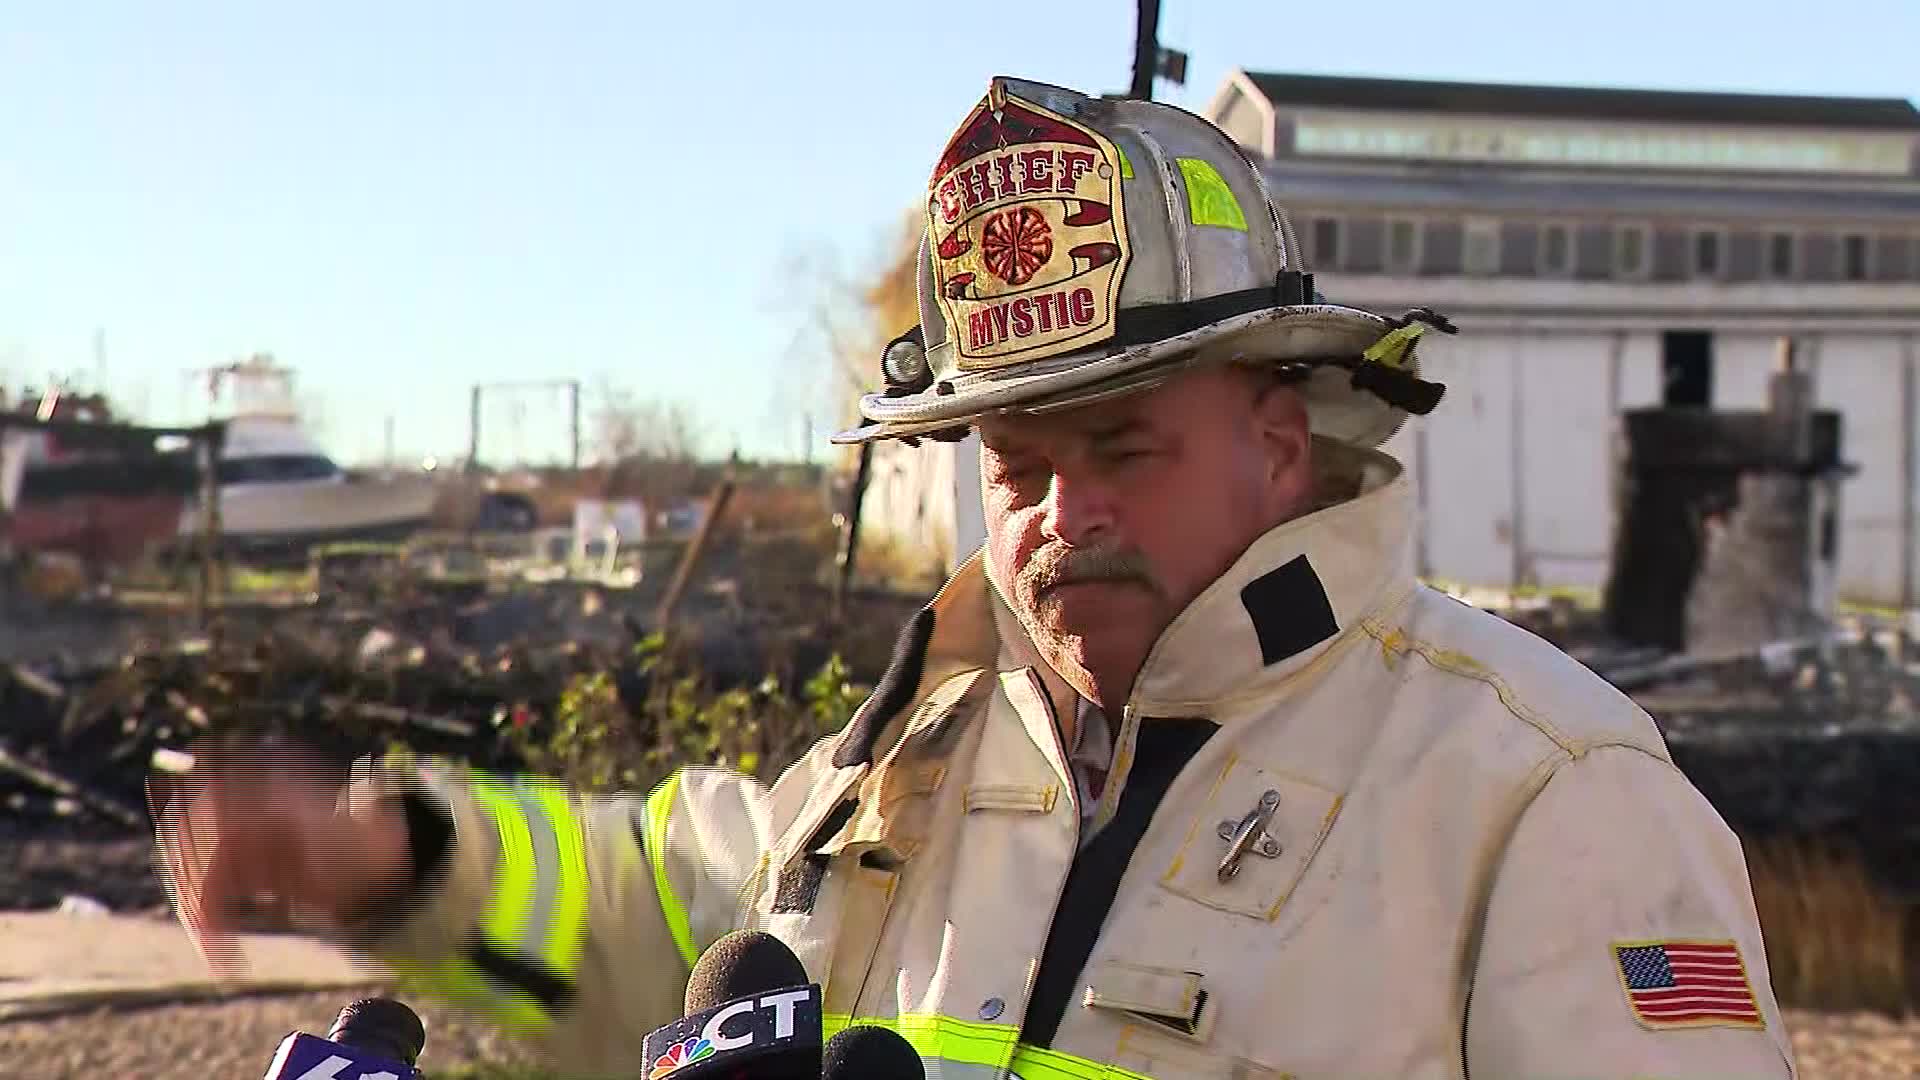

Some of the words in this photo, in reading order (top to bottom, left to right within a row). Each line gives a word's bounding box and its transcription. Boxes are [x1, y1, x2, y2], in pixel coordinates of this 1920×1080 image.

[938, 150, 1095, 223] CHIEF
[969, 288, 1095, 350] MYSTIC
[702, 990, 810, 1051] CT
